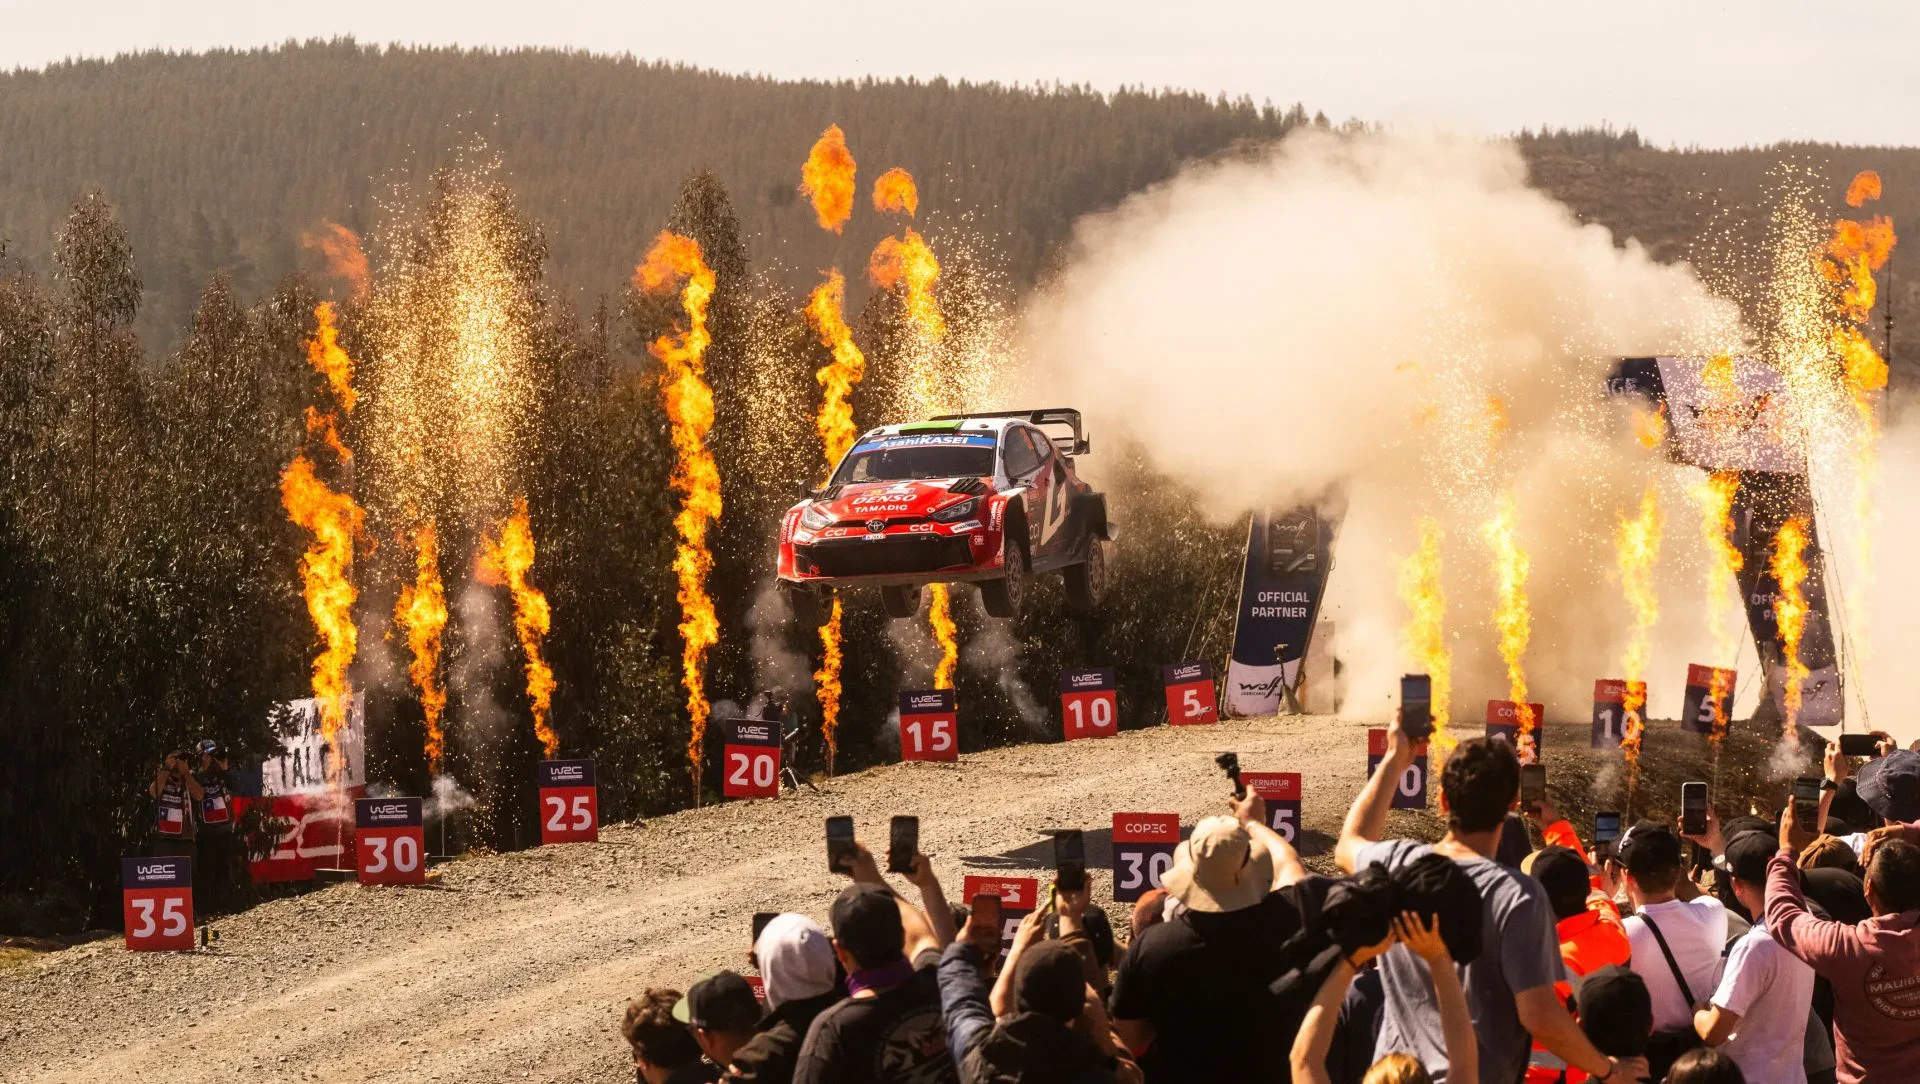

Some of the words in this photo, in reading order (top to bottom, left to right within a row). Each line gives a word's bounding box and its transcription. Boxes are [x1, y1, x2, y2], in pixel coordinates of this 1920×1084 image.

[878, 436, 969, 449] AsahiKASEI
[851, 494, 918, 505] DENSO
[854, 504, 908, 513] TAMADIC
[824, 528, 848, 537] CCI
[909, 524, 934, 532] CCI
[1258, 591, 1310, 603] OFFICIAL
[1252, 606, 1307, 618] PARTNER
[1174, 665, 1202, 676] WRC
[1071, 673, 1103, 682] WRC
[910, 694, 942, 703] WRC
[1183, 689, 1201, 718] 5
[1068, 698, 1112, 729] 10
[1697, 694, 1718, 723] 5
[737, 725, 769, 735] WRC
[1598, 708, 1640, 741] 10
[906, 720, 952, 753] 15
[550, 766, 583, 775] WRC
[729, 752, 775, 788] 20
[1250, 779, 1289, 787] SERNATUR
[370, 804, 408, 814] WRC
[545, 796, 592, 831] 25
[1125, 823, 1168, 834] COPEC
[364, 835, 418, 874] 30
[137, 864, 176, 874] WRC
[1119, 852, 1174, 890] 30
[131, 897, 187, 938] 35
